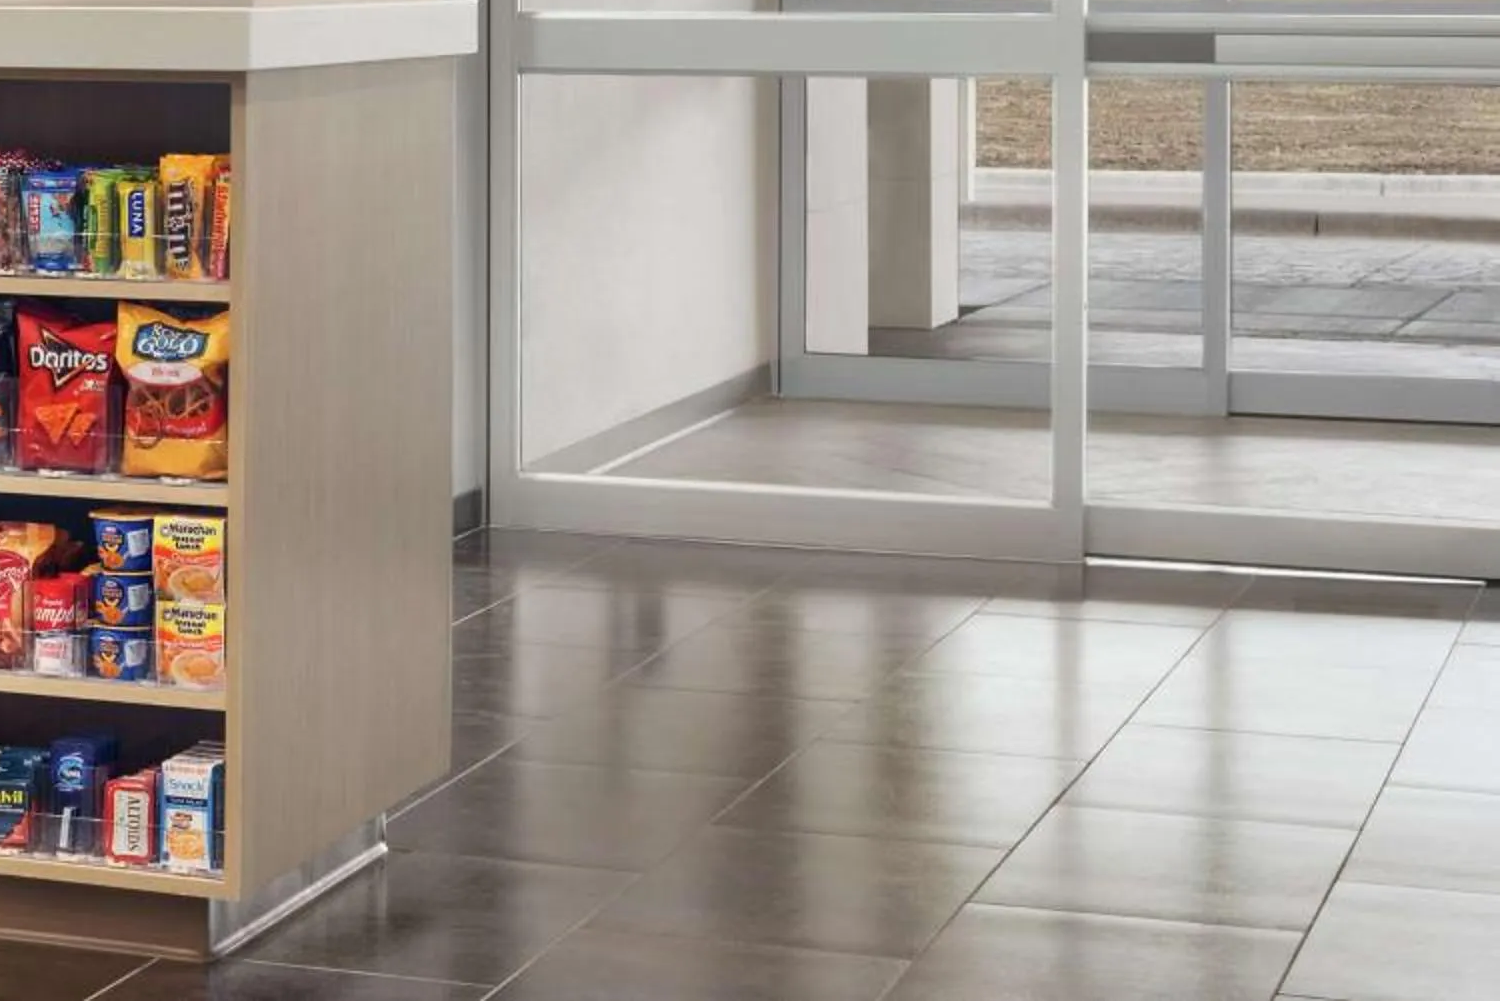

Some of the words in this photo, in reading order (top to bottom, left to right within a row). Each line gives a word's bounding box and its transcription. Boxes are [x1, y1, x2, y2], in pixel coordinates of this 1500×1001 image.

[131, 190, 144, 235] LUNA
[30, 345, 108, 371] Doritos
[127, 796, 141, 852] ALTOIDS
